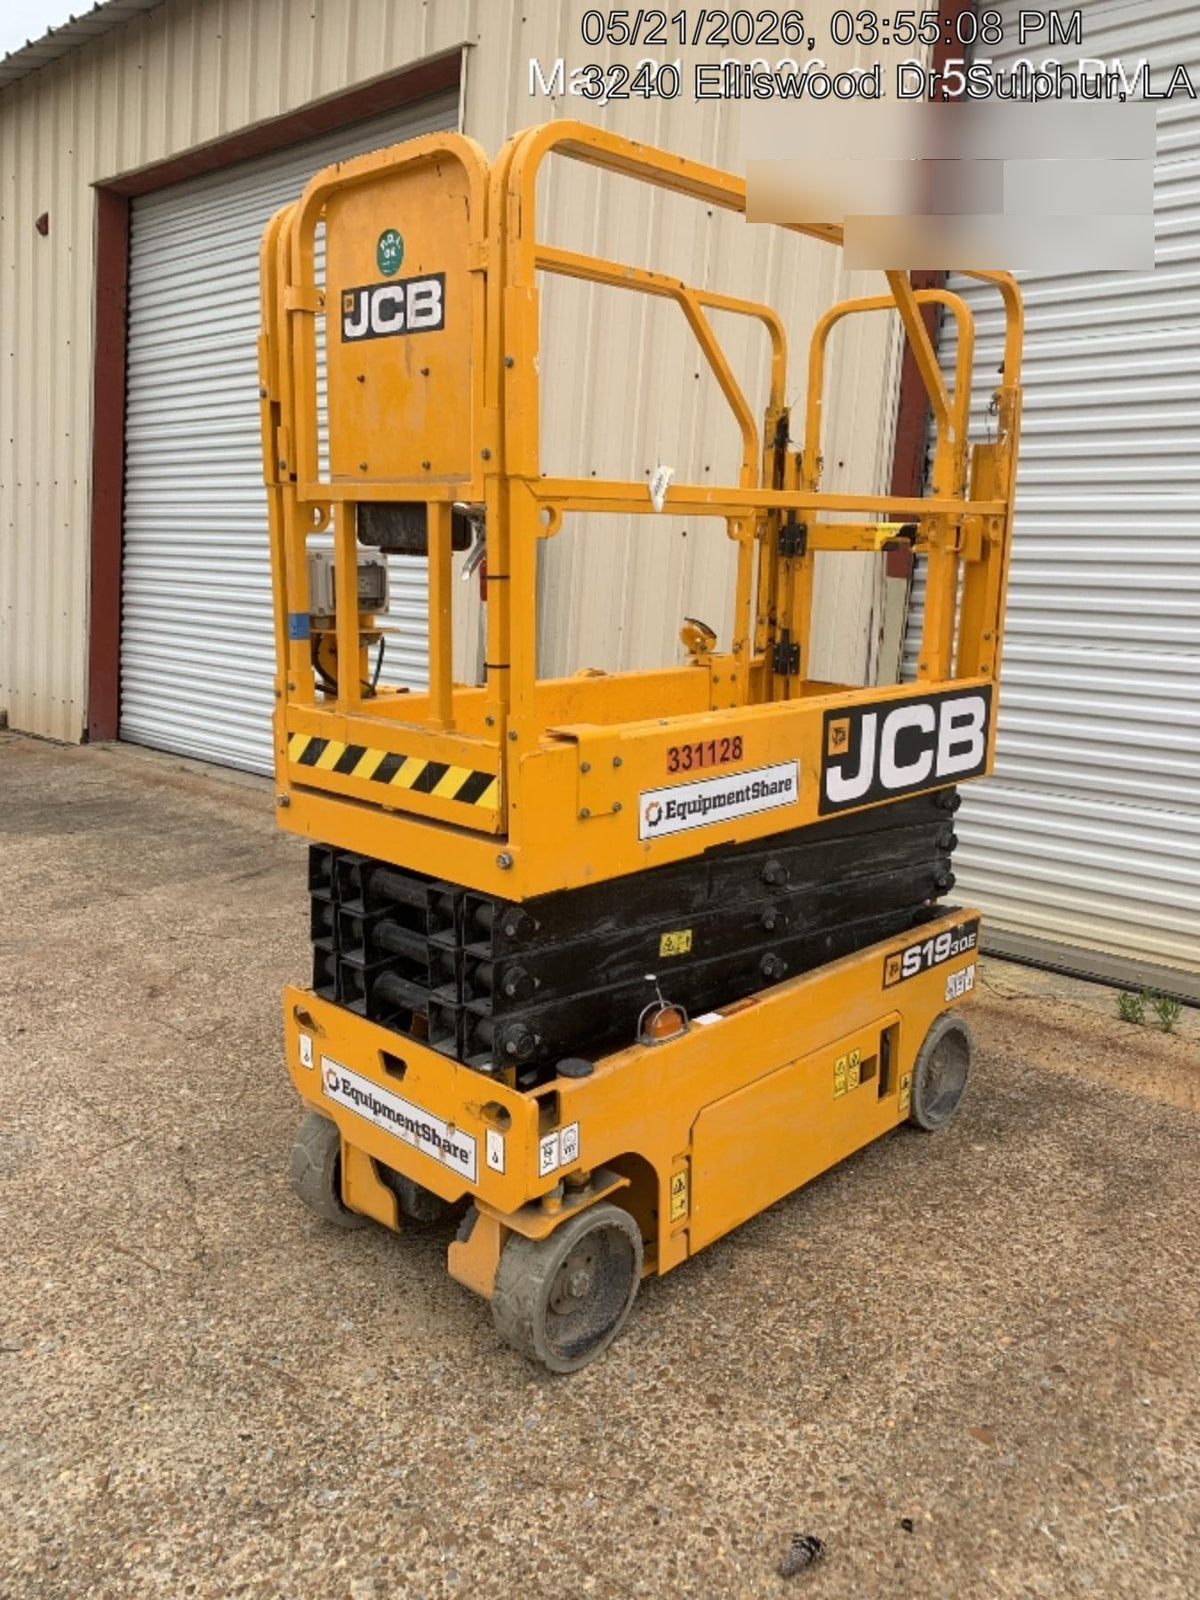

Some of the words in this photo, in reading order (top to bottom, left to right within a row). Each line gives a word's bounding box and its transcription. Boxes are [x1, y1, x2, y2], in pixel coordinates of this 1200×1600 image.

[344, 280, 442, 338] JCB
[668, 735, 743, 773] 331128
[826, 697, 986, 803] JCB
[665, 777, 792, 820] EquipmentShare
[341, 1078, 470, 1165] EquipmentShare
